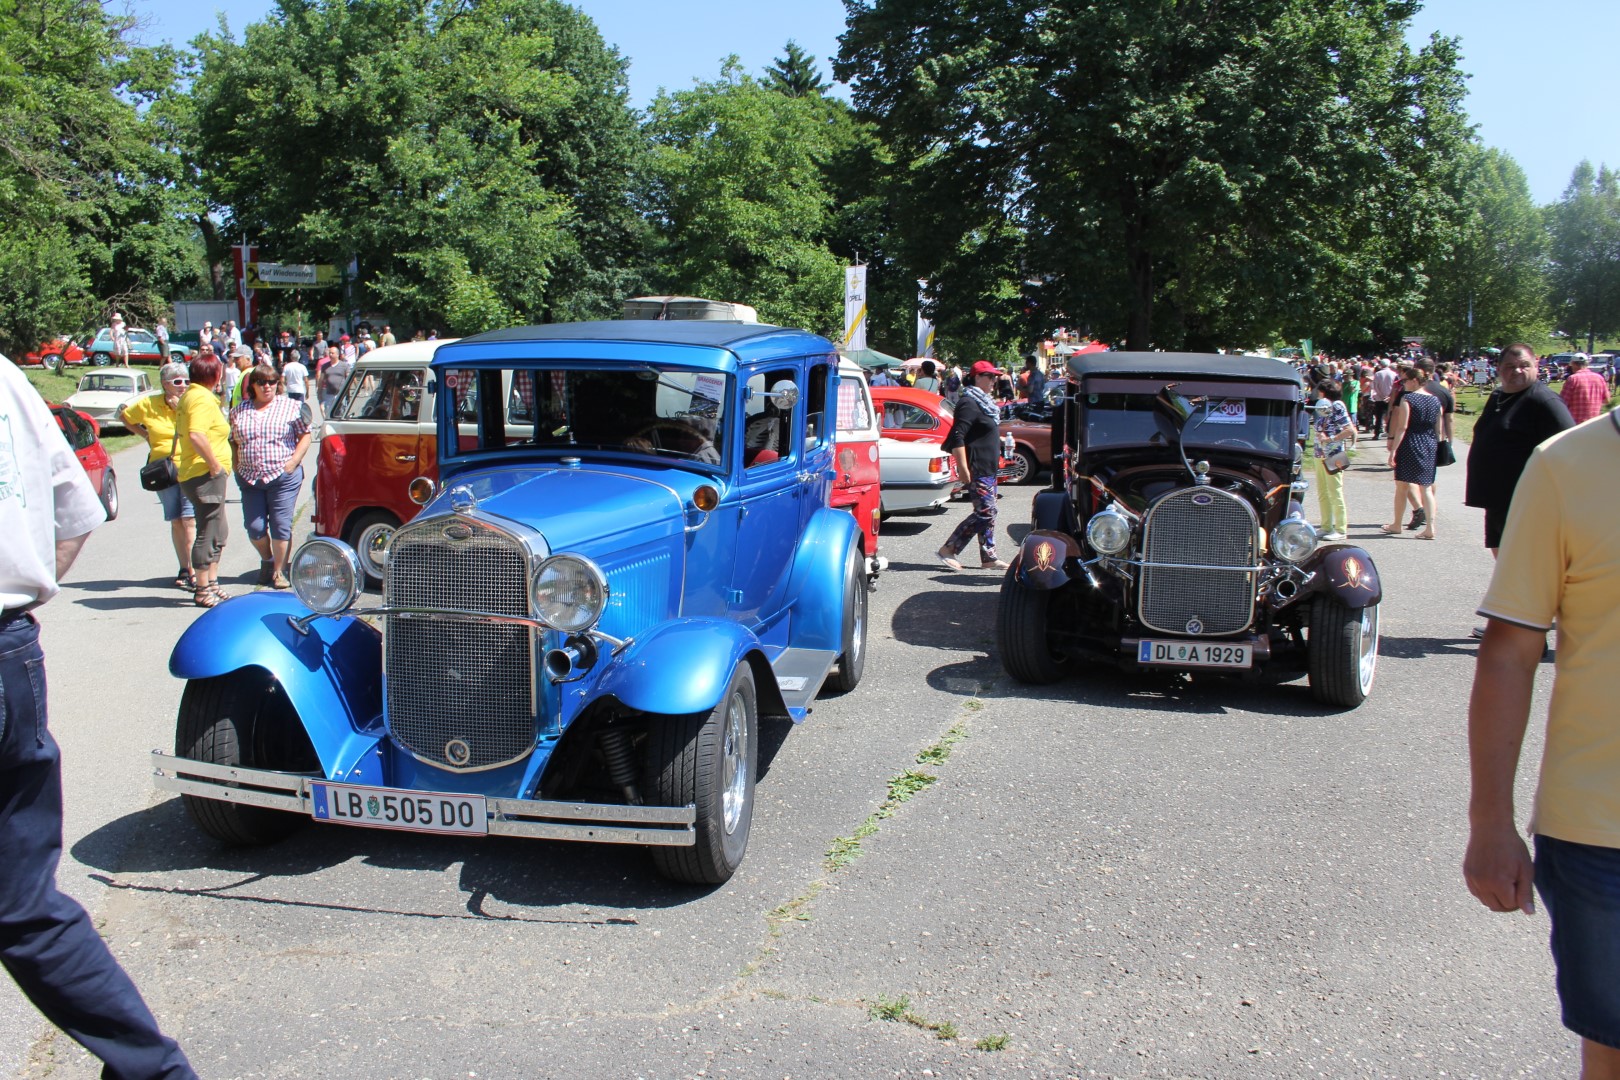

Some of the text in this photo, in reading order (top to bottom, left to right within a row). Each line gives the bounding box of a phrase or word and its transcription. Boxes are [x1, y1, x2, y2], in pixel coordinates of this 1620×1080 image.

[1220, 403, 1242, 415] 300
[1155, 644, 1244, 663] DL A 1929
[318, 805, 326, 814] A
[333, 790, 474, 828] LB 505 DO
